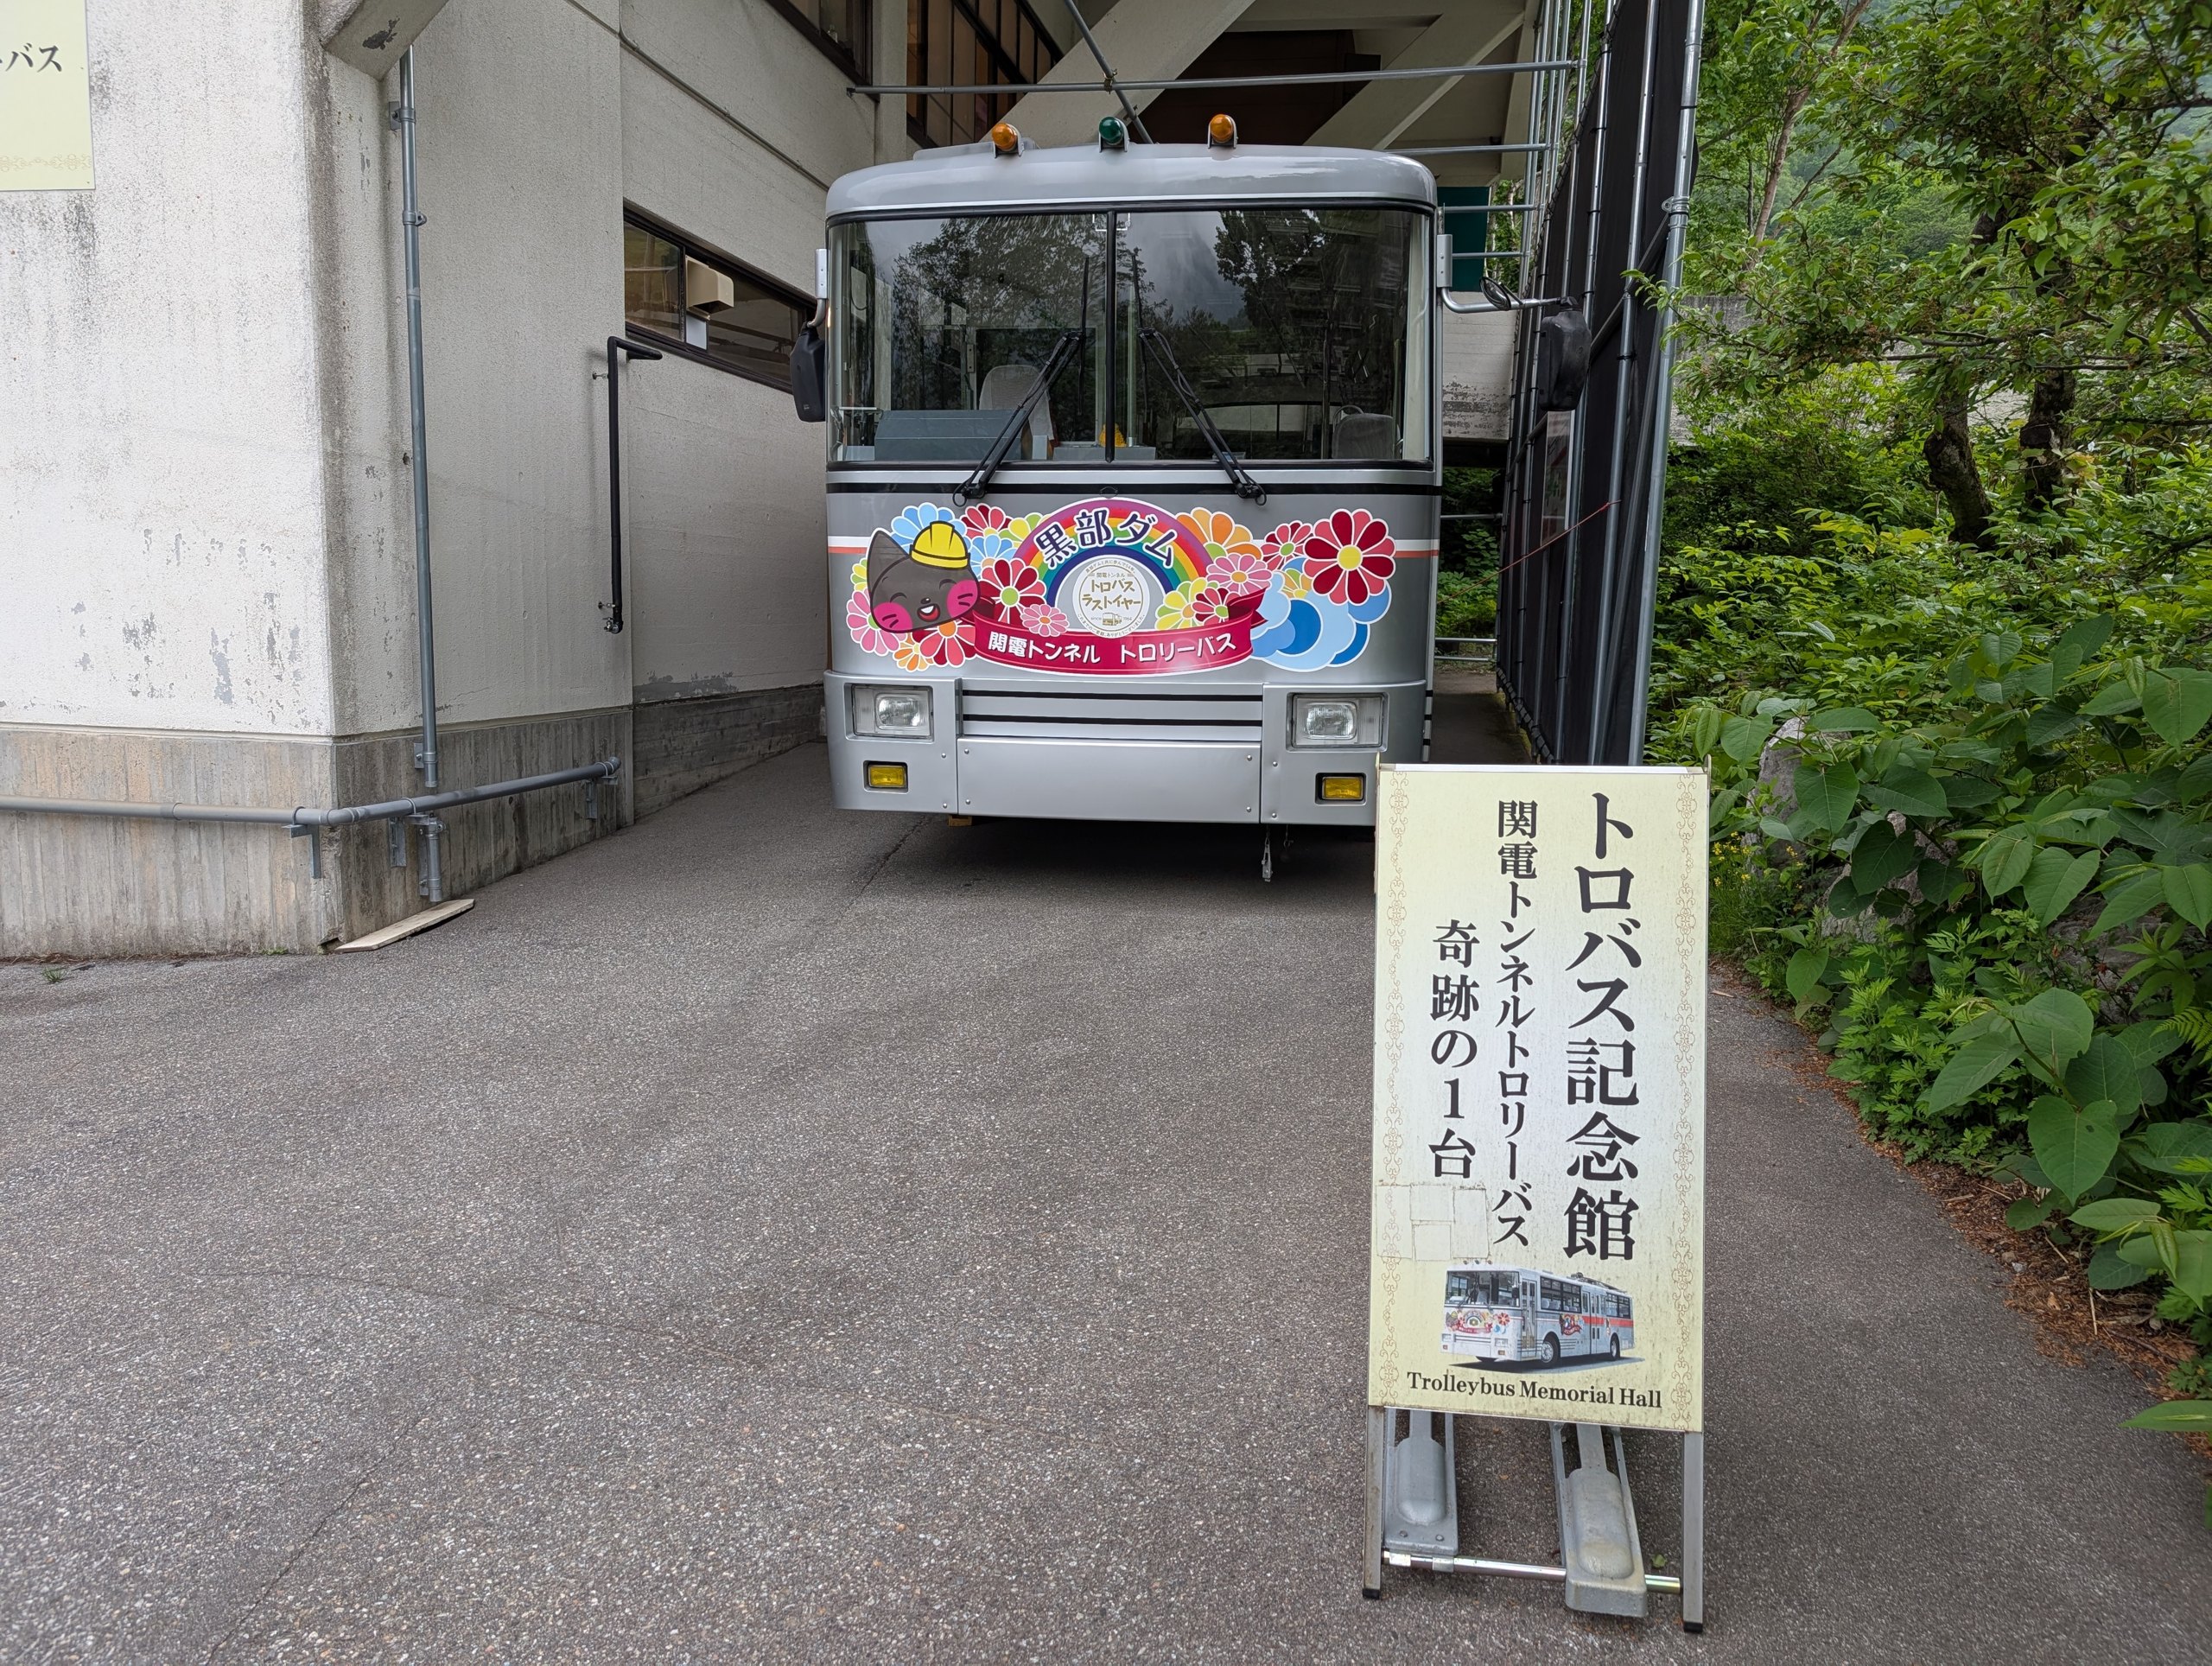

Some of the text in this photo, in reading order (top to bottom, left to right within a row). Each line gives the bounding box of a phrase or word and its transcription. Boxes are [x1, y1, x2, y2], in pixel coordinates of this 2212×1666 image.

[0, 42, 62, 73] バス
[1035, 509, 1175, 568] 黒部ダム
[1082, 594, 1141, 611] ラストイヤー
[1091, 578, 1135, 593] トロバス
[988, 631, 1236, 664] 関電トンネル トロリーバス
[1491, 799, 1538, 1247] 関電トンネルトロリーバス
[1561, 792, 1642, 1262] トロバス記念館
[1428, 919, 1480, 1180] 奇跡の1台
[1407, 1371, 1662, 1408] Trolleybus Memorial Hall
